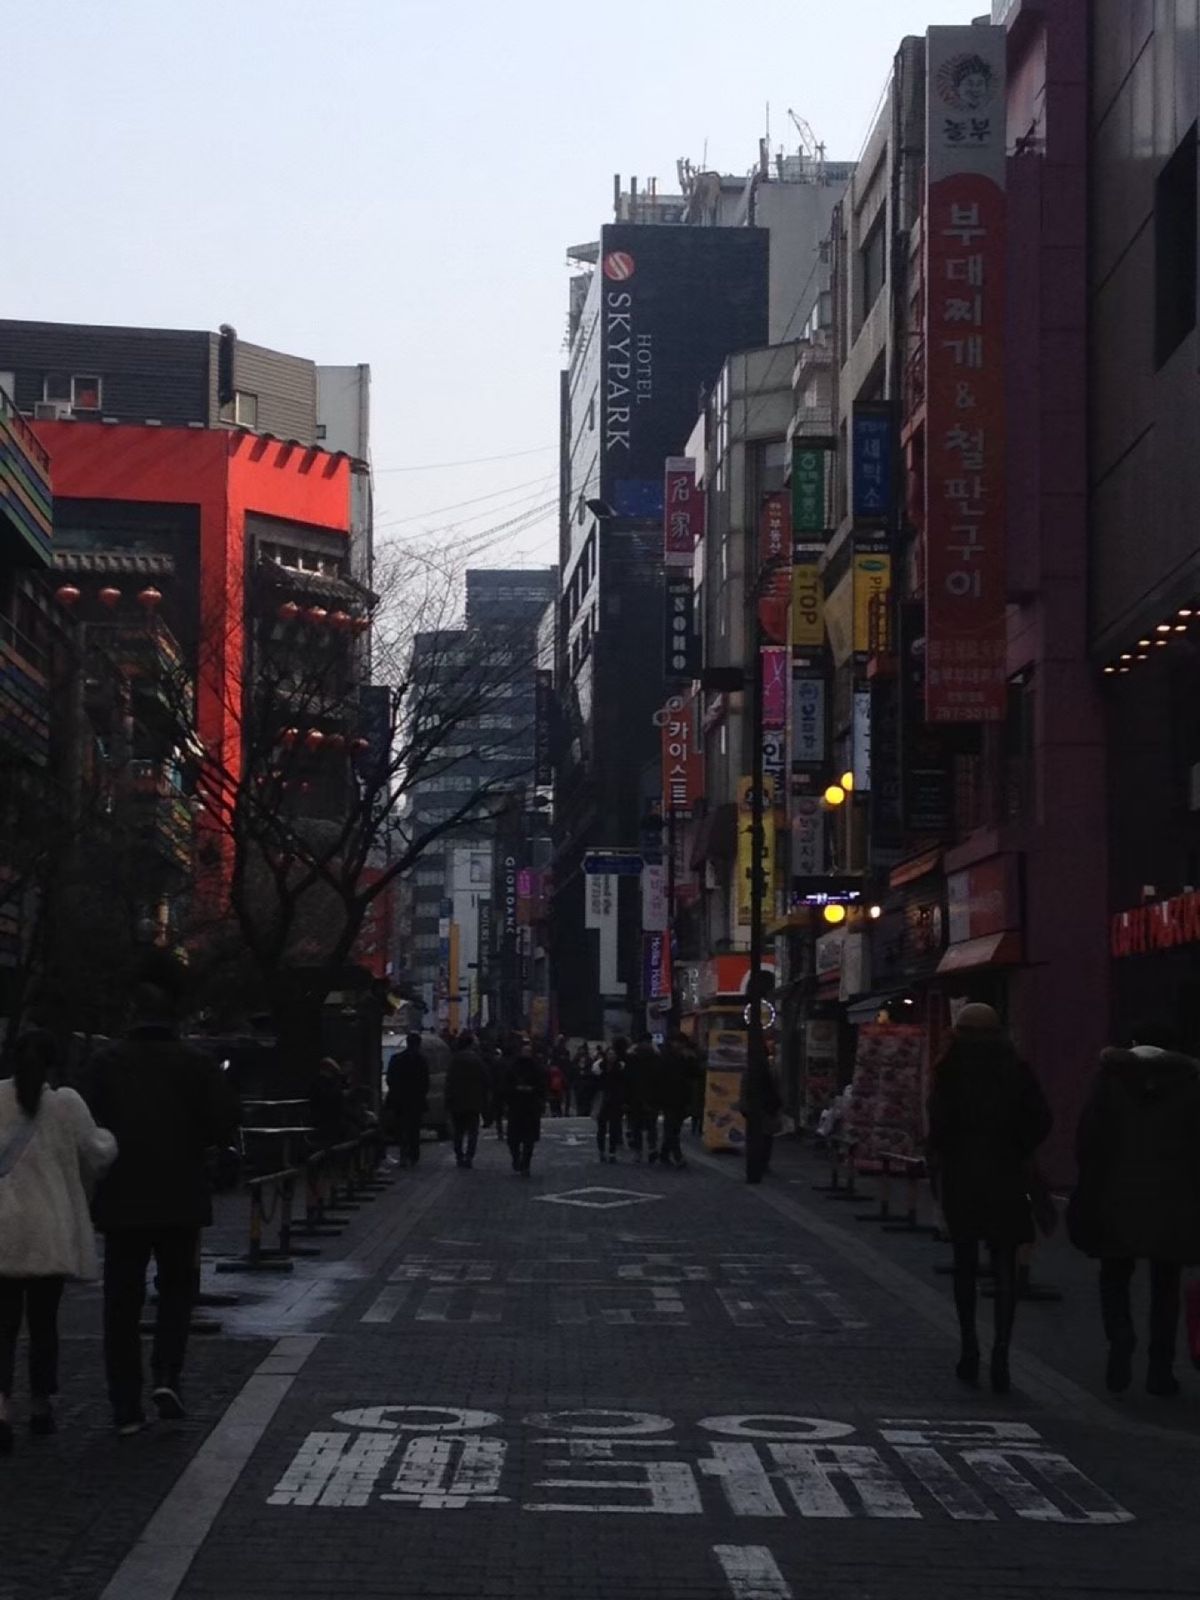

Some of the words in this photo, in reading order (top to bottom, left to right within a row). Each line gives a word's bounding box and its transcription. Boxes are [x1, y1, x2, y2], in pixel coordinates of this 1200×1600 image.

[944, 118, 991, 142] 놀부
[942, 202, 985, 369] 부대찌개
[606, 291, 632, 451] SKYPARK
[636, 333, 653, 404] HOTEL
[955, 381, 975, 409] &
[671, 475, 690, 538] 名家
[945, 423, 985, 598] 철판구이
[672, 597, 687, 670] SOHO
[799, 581, 818, 625] TOP
[669, 721, 690, 804] 카이스트
